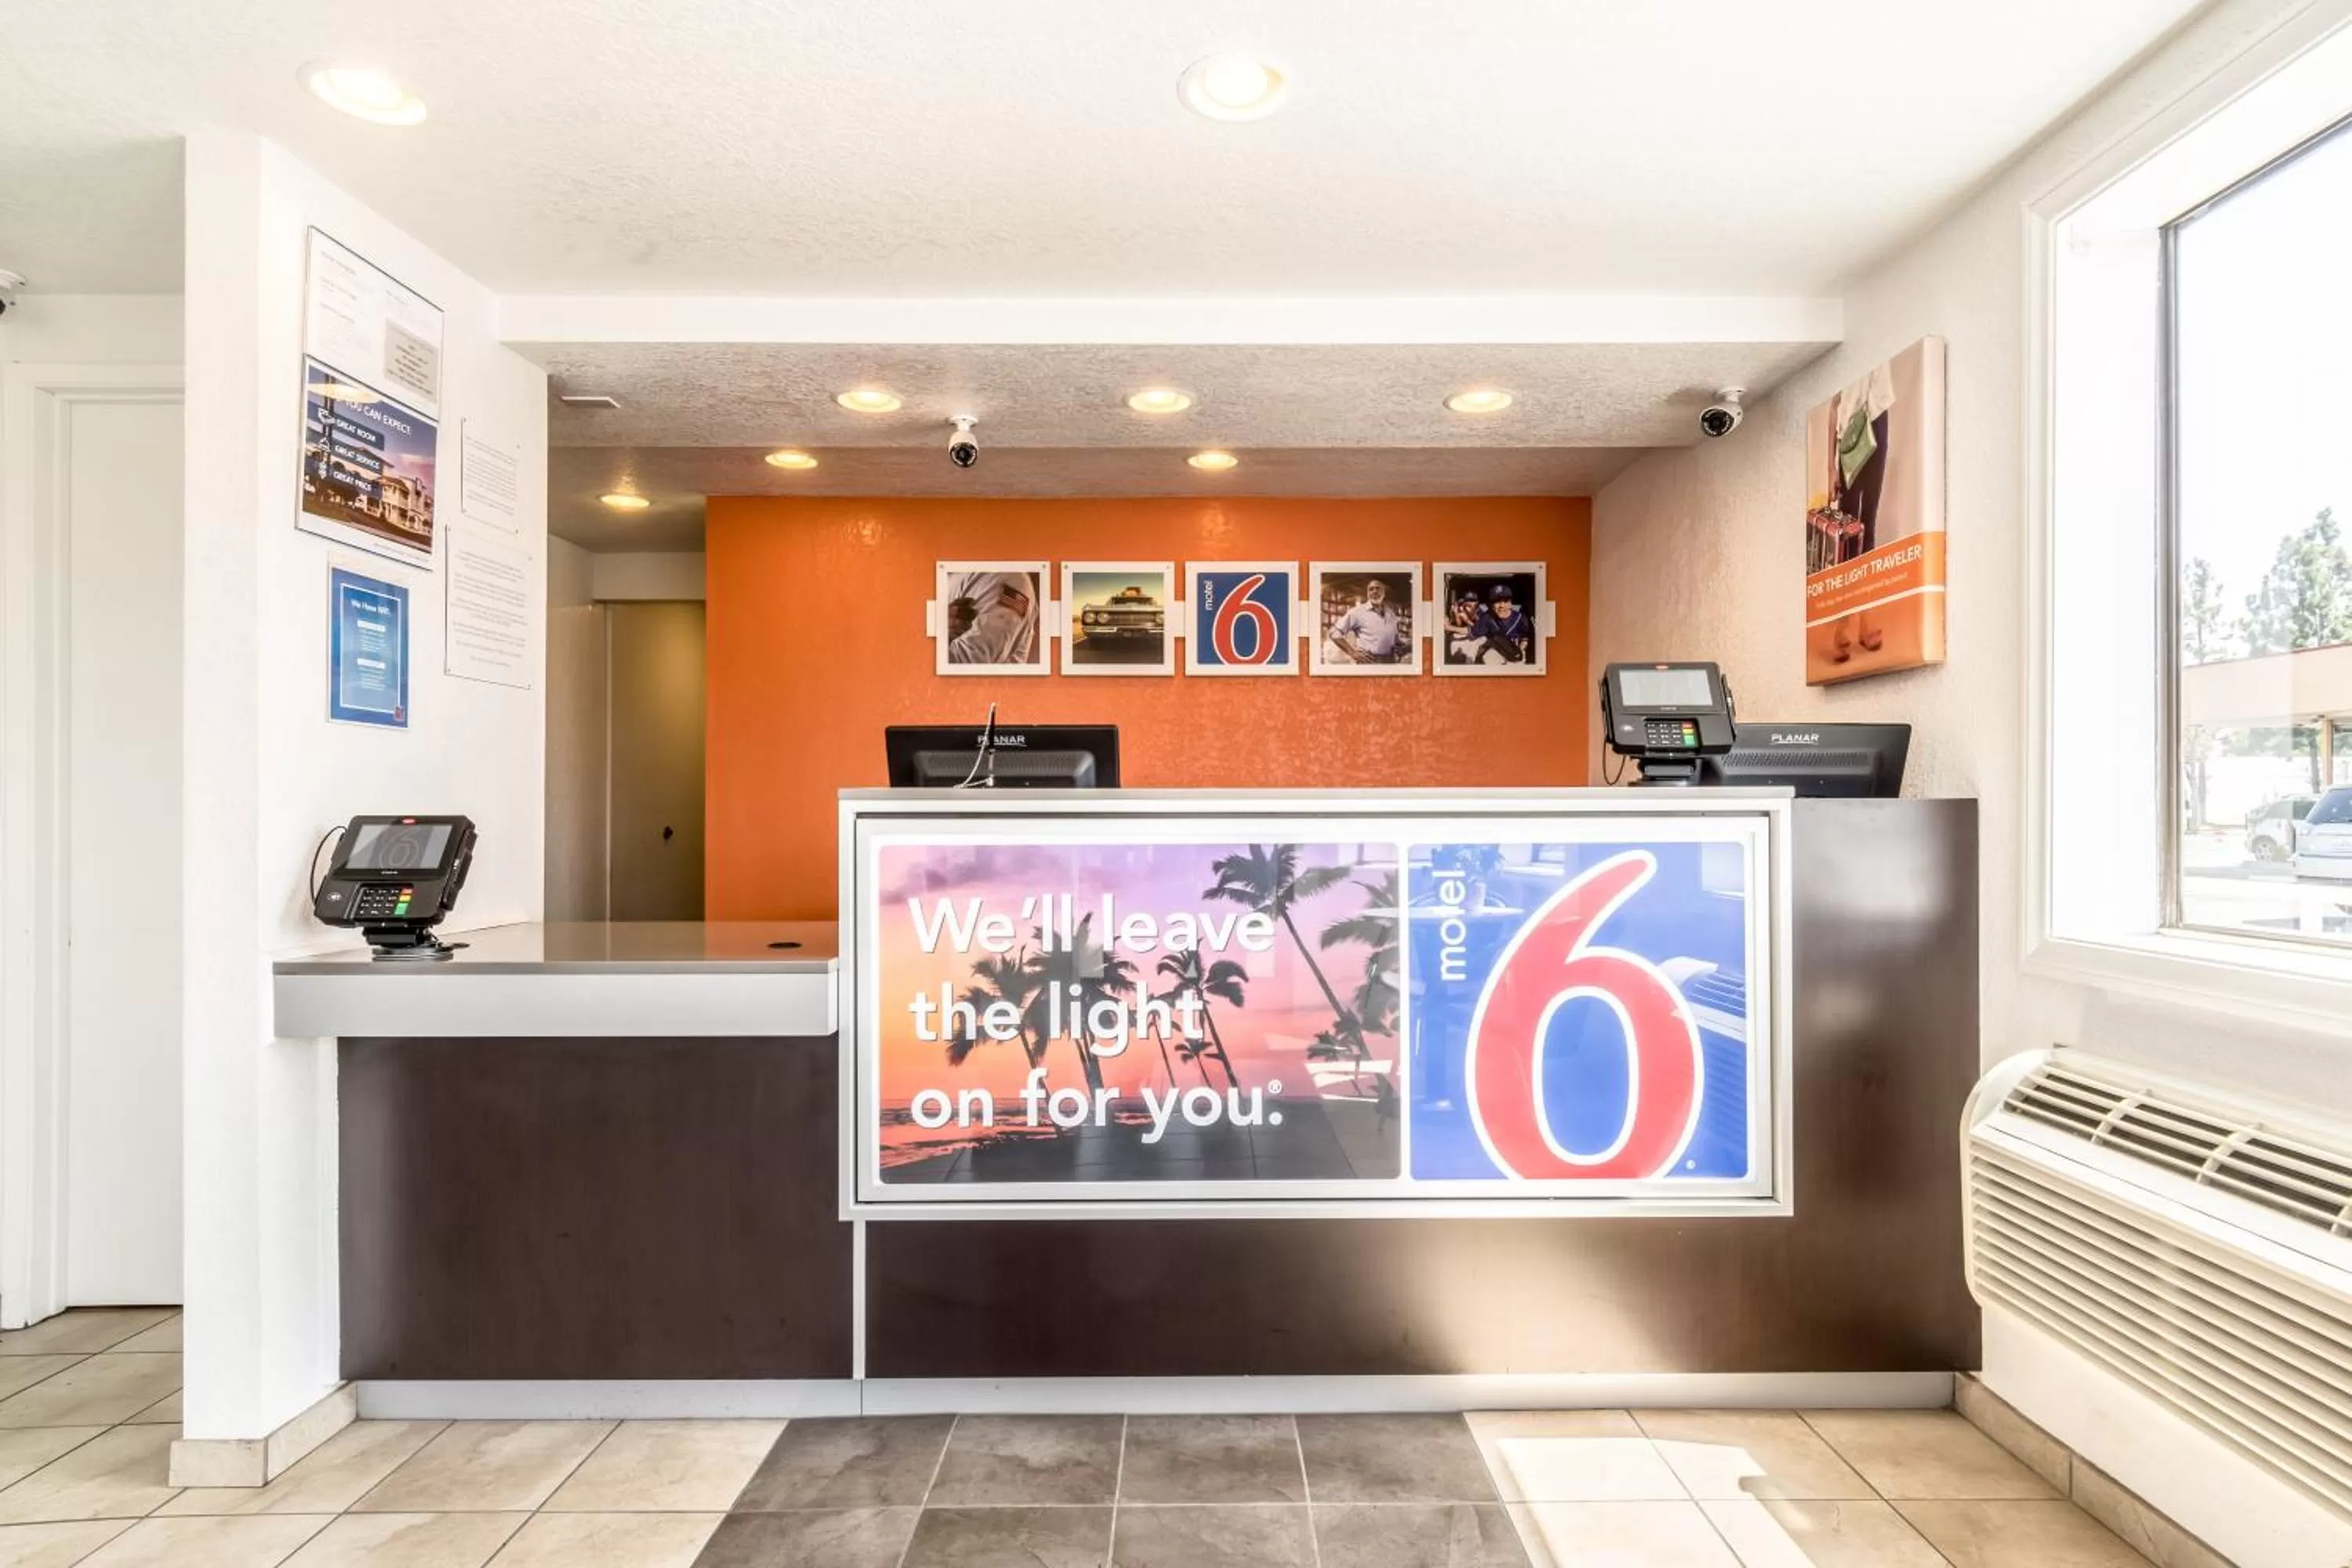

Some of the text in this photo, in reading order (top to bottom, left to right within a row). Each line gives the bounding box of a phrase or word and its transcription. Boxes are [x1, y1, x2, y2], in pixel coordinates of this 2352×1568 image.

[336, 419, 376, 442] GREAT ROOM
[364, 405, 381, 421] CAN
[333, 471, 372, 492] GREAT PRICE
[335, 445, 379, 470] GREAT SERVICE
[1807, 581, 1825, 597] FOR
[1824, 575, 1843, 591] THE
[1844, 564, 1869, 584] LIGHT
[1871, 545, 1922, 574] TRAVELER
[1204, 575, 1277, 665] motel 6
[1771, 733, 1820, 742] PLANAR
[1103, 893, 1276, 953] leave
[909, 980, 1205, 1058] the light
[1432, 849, 1704, 1180] motel 6
[911, 1085, 993, 1130] on
[1020, 1068, 1120, 1128] for
